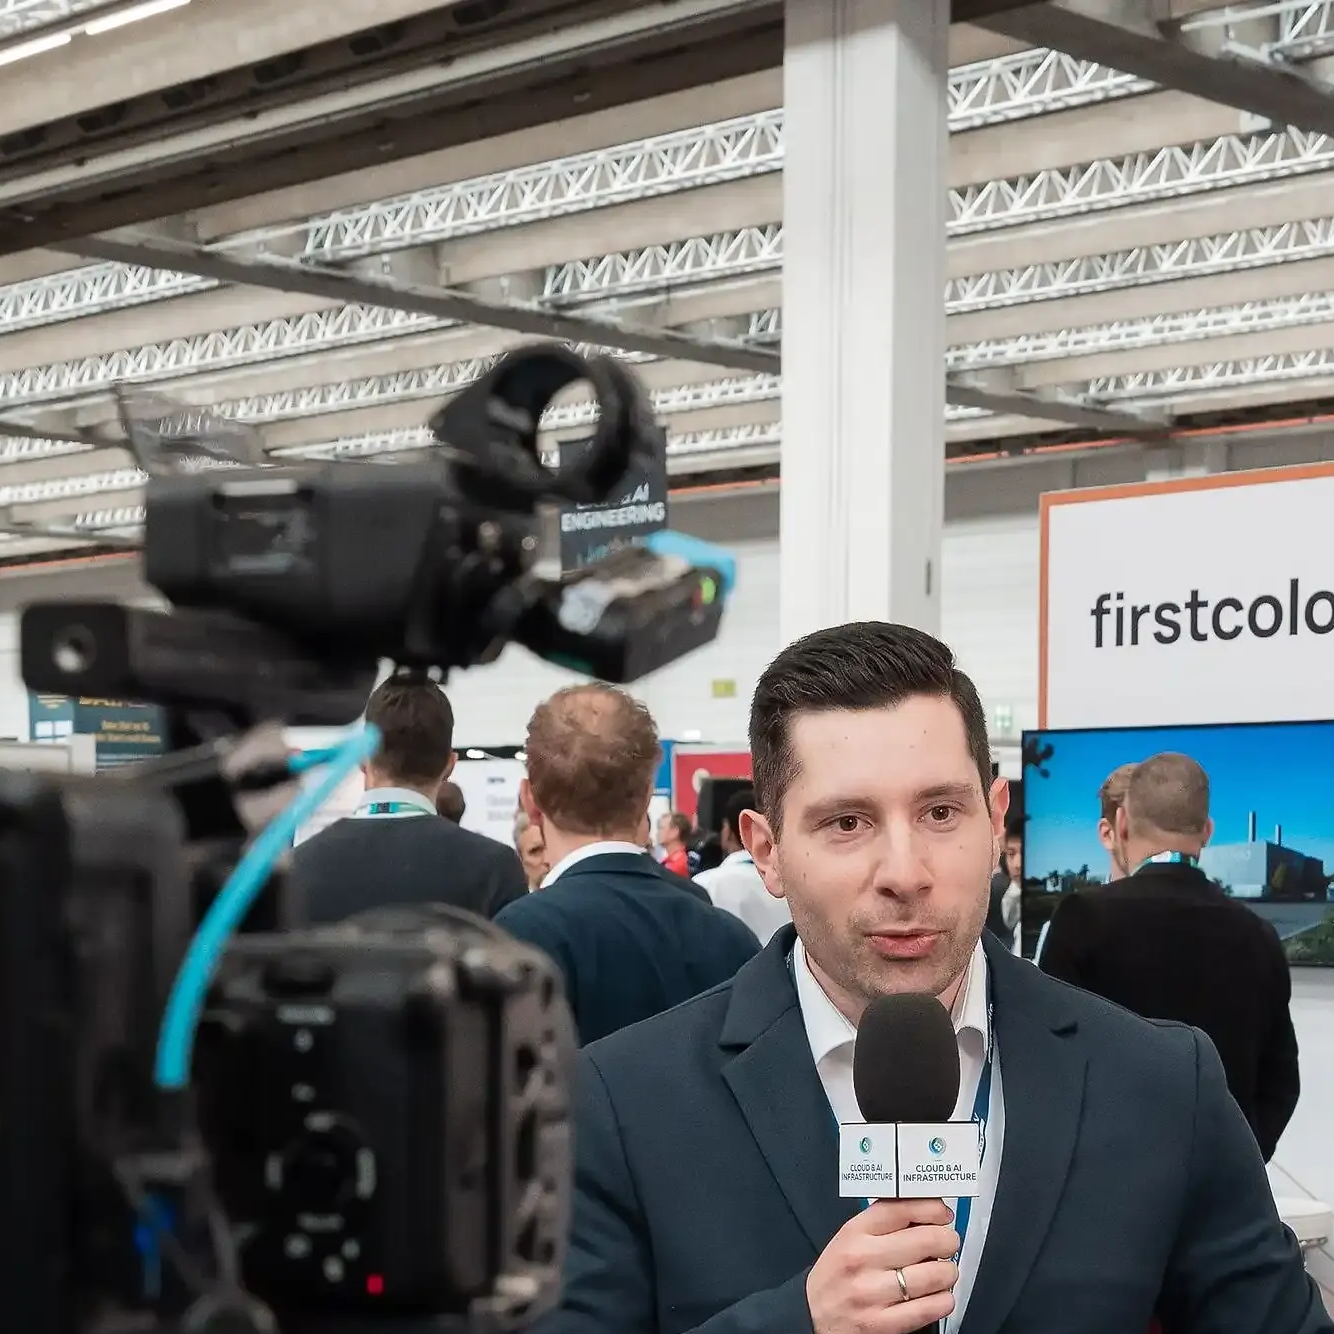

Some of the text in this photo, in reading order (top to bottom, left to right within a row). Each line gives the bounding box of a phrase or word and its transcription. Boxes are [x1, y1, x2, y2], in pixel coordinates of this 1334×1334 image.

[561, 501, 666, 532] ENGINEERING
[850, 1164, 870, 1172] CLOUD
[916, 1164, 944, 1172] CLOUD
[953, 1164, 962, 1172] AI
[842, 1172, 893, 1181] INFRASTRUCTURE
[903, 1173, 976, 1182] INFRASTRUCTURE
